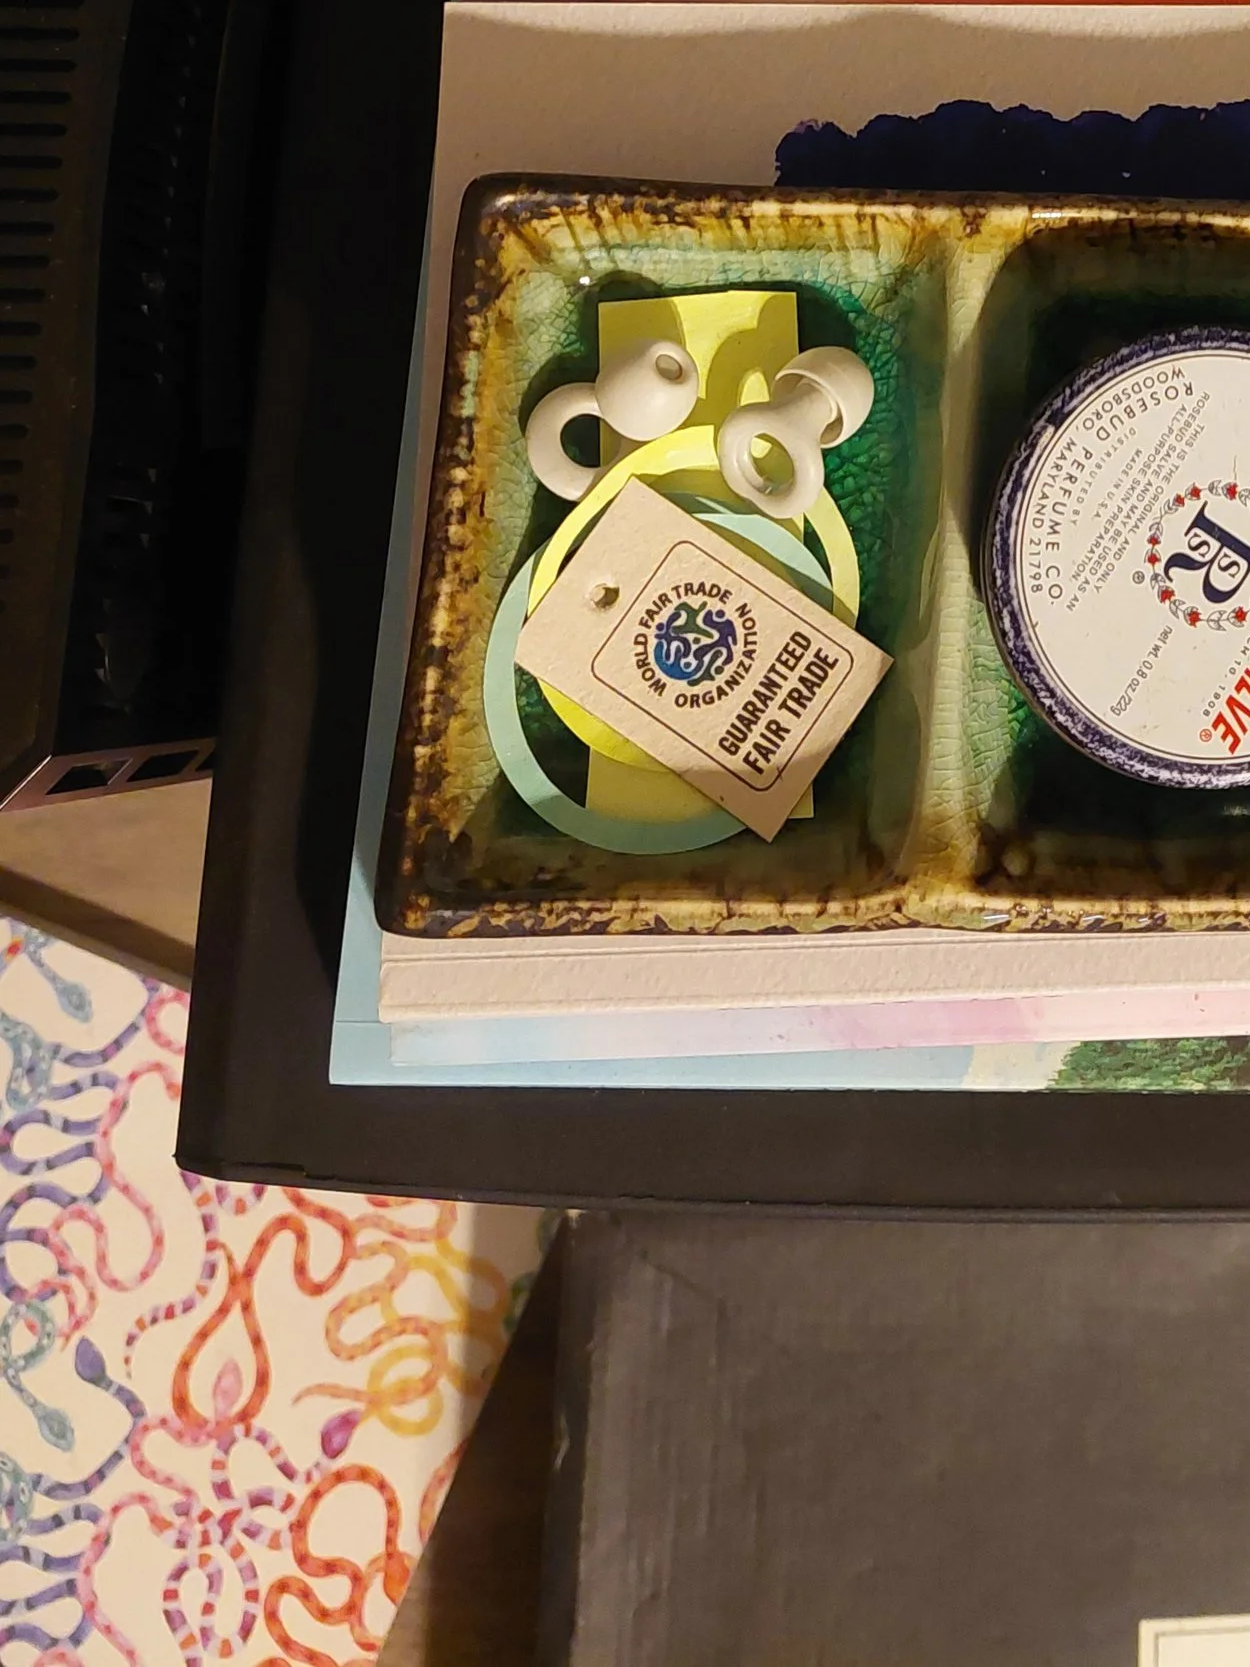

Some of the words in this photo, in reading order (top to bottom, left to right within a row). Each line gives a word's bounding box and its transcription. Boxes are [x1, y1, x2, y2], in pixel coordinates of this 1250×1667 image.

[1096, 381, 1193, 441] ROSEBUD
[1174, 391, 1210, 442] ROSEBUD
[1138, 403, 1187, 478] ALL-PURPOSE
[1185, 424, 1205, 448] THIS
[1076, 426, 1136, 504] DISTRIBUTED
[1121, 448, 1142, 477] MADE
[1151, 443, 1177, 479] SALVE
[1176, 448, 1188, 461] IS
[1032, 437, 1078, 529] MARYLAND
[1113, 477, 1123, 490] IN
[1136, 478, 1153, 502] AND
[1161, 463, 1180, 485] THE
[1045, 446, 1093, 552] PERFUME
[1121, 477, 1141, 504] SKIN
[1071, 509, 1080, 526] BY
[1121, 503, 1138, 529] MAY
[1128, 485, 1164, 534] ORIGINAL
[1108, 528, 1122, 545] BE
[1113, 536, 1130, 561] AND
[1028, 537, 1043, 593] 21798
[1089, 545, 1112, 576] USED
[671, 581, 733, 605] TRADE
[1045, 565, 1063, 605] CO.
[1077, 576, 1090, 594] AS
[1093, 562, 1115, 594] ONLY
[638, 592, 673, 630] FAIR
[1066, 593, 1080, 612] AN
[1157, 625, 1173, 645] net
[633, 633, 668, 697] WORLD
[674, 602, 758, 709] ORGANIZATION
[717, 630, 812, 759] GUARANTEED
[1203, 685, 1226, 717] 1908
[742, 719, 791, 776] FAIR
[777, 646, 840, 722] TRADE
